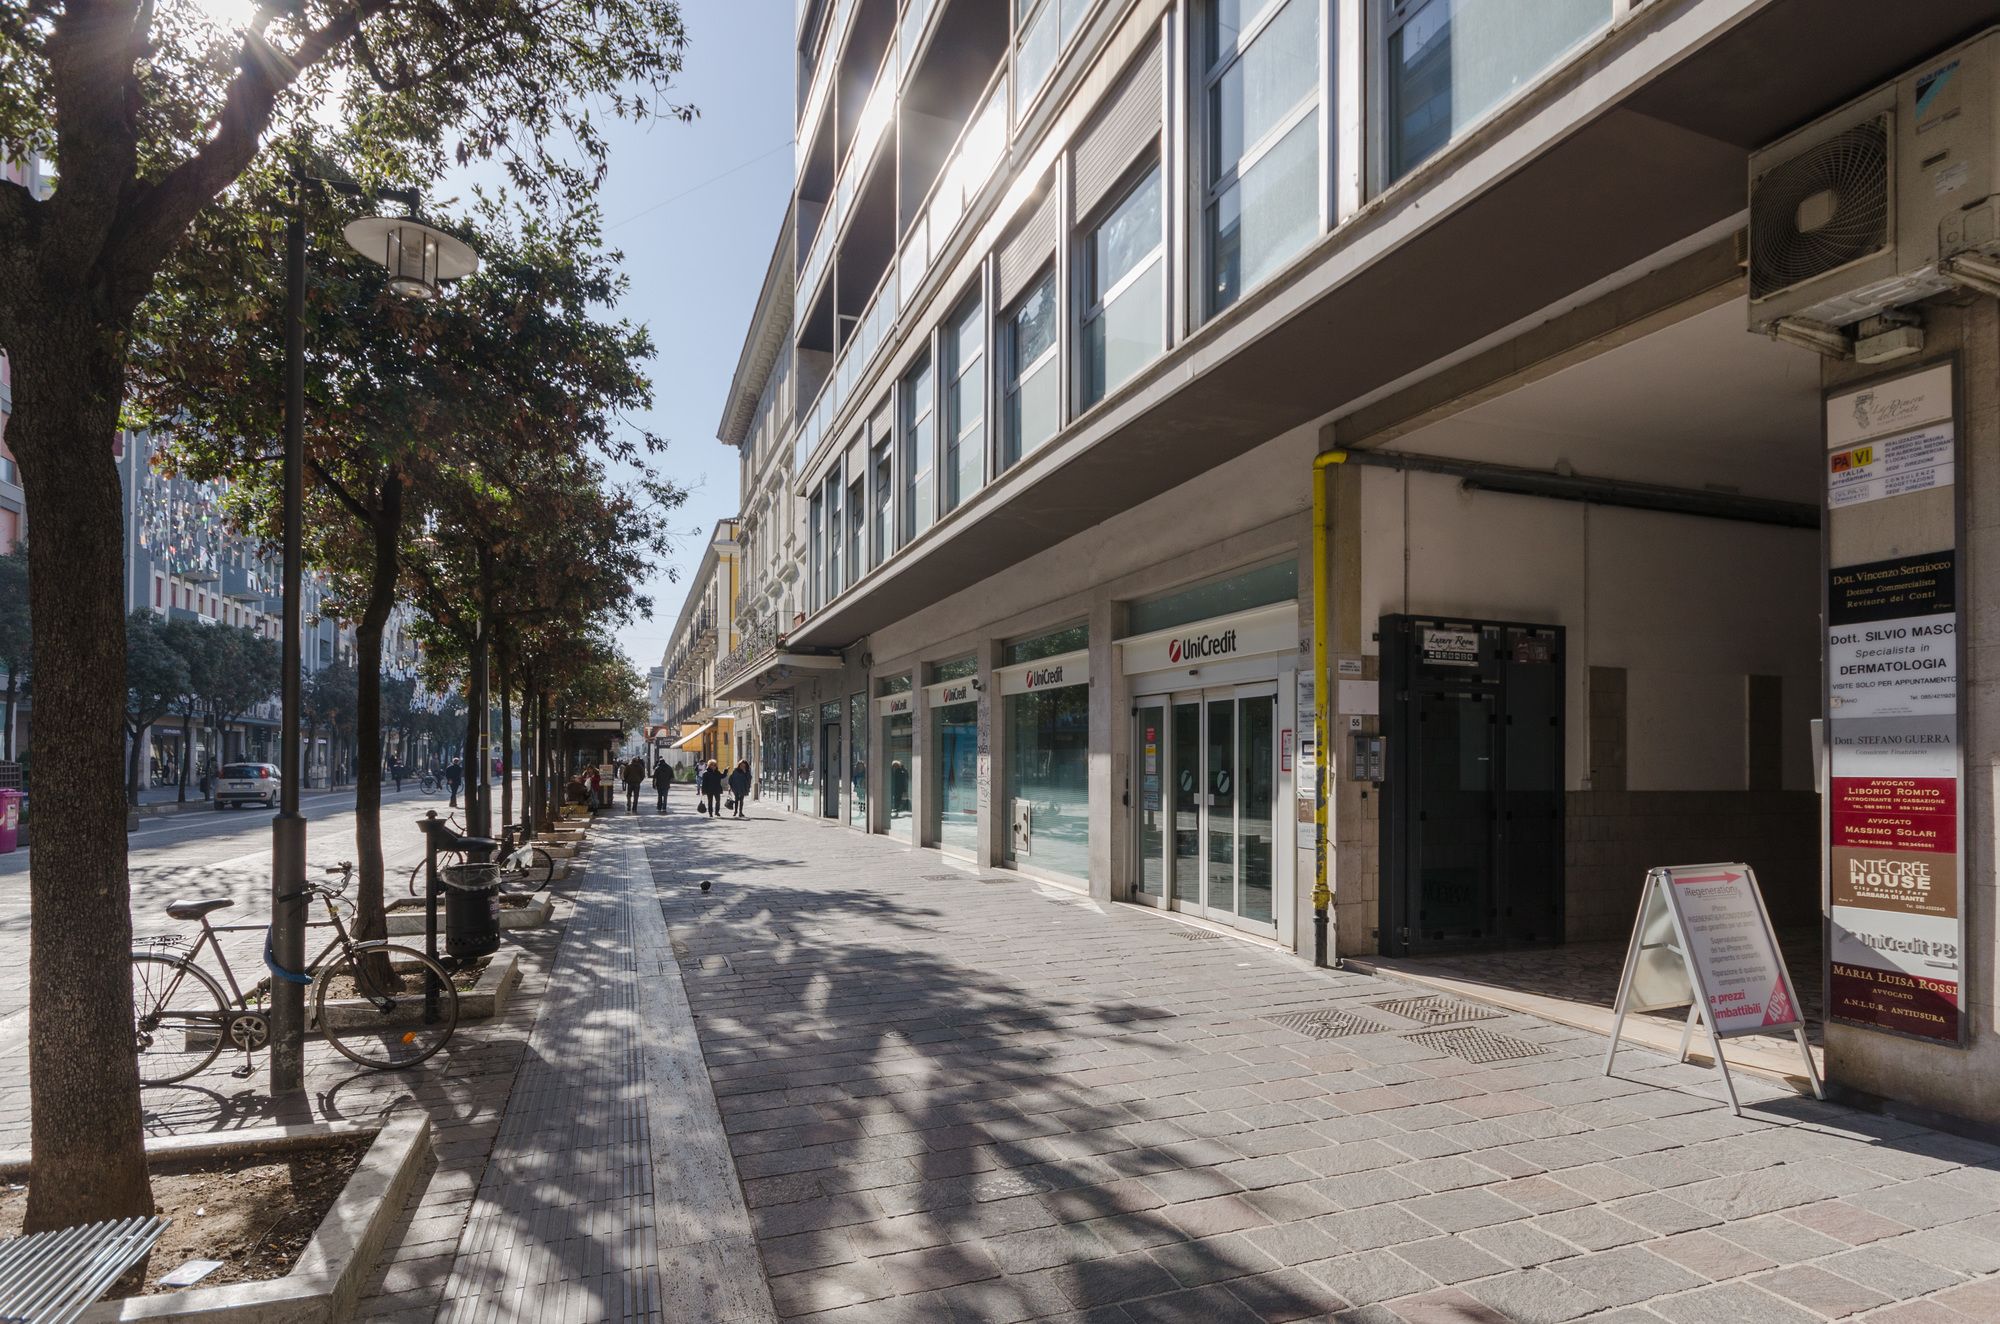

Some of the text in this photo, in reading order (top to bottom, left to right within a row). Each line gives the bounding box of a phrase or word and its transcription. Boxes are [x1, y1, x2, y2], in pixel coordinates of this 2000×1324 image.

[1834, 455, 1849, 469] PA
[1856, 448, 1870, 463] VI
[1832, 472, 1872, 486] arredamenti
[1838, 468, 1865, 478] ITALIA
[1834, 562, 1951, 586] Dott. Vincenzo Serraiocco
[1846, 579, 1936, 597] Dottore Commercialista
[1847, 598, 1886, 608] Revisore
[1909, 591, 1936, 600] Conti
[1182, 628, 1236, 660] UniCredit
[1831, 634, 1860, 645] Dott.
[1865, 628, 1907, 642] SILVIO
[1855, 644, 1930, 659] Specialista in
[1840, 658, 1948, 676] DERMATOLOGIA
[1034, 666, 1063, 686] UniCredit
[1832, 682, 1854, 690] VISITE
[1856, 680, 1876, 688] SOLO
[1894, 676, 1956, 686] APPUNTAMENTO
[948, 686, 966, 702] UniCredit
[1834, 734, 1951, 745] Dott. STEFANO GUERRA
[1848, 787, 1940, 796] LIBORIO ROMITO
[1868, 818, 1912, 826] AVVOCATO
[1844, 826, 1937, 838] MASSIMO SOLARI
[1850, 872, 1931, 890] HOUSE
[1858, 932, 1930, 956] UniCredit
[1833, 964, 1958, 995] MARIA LUISA ROSSI
[1710, 988, 1746, 1005] a prezzi
[1872, 988, 1914, 1000] AVVOCATO
[1715, 1002, 1762, 1019] imbattibili
[1768, 991, 1786, 1022] 40%
[1891, 1007, 1946, 1024] ANTIUSURA
